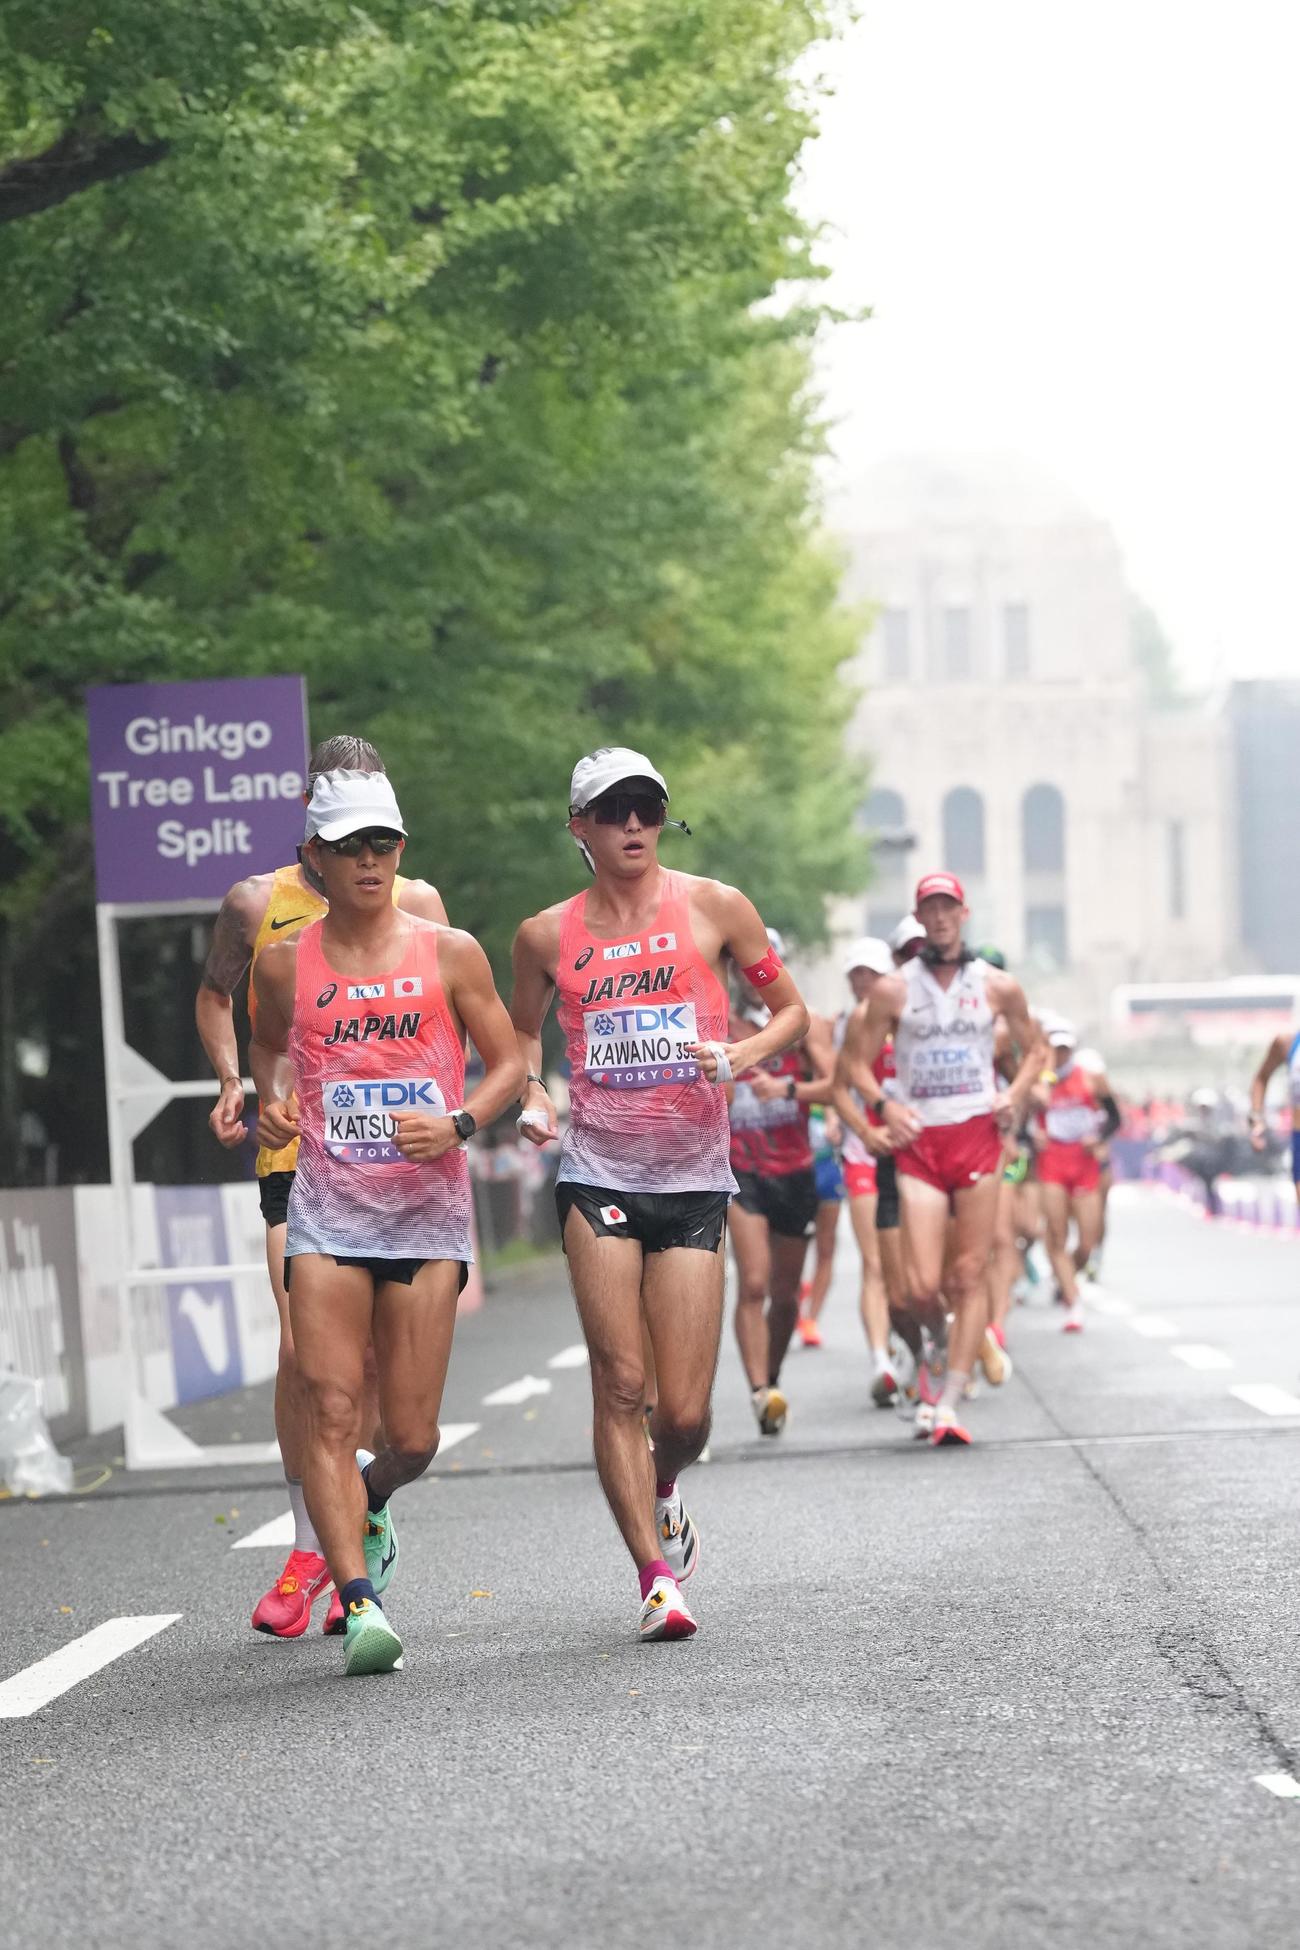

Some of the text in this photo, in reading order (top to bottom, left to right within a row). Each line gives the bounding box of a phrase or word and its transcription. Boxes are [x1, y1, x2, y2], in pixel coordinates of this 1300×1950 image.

[124, 715, 272, 761] Ginkgo
[97, 767, 303, 809] Tree Lane
[156, 818, 252, 867] Split
[606, 943, 639, 959] ACN
[350, 985, 384, 999] ACN
[581, 965, 675, 1005] JAPAN
[323, 1012, 421, 1046] JAPAN
[612, 1005, 687, 1033] TDK
[590, 1036, 671, 1067] KAWANO
[354, 1081, 437, 1106] TDK
[355, 1146, 402, 1158] TOK
